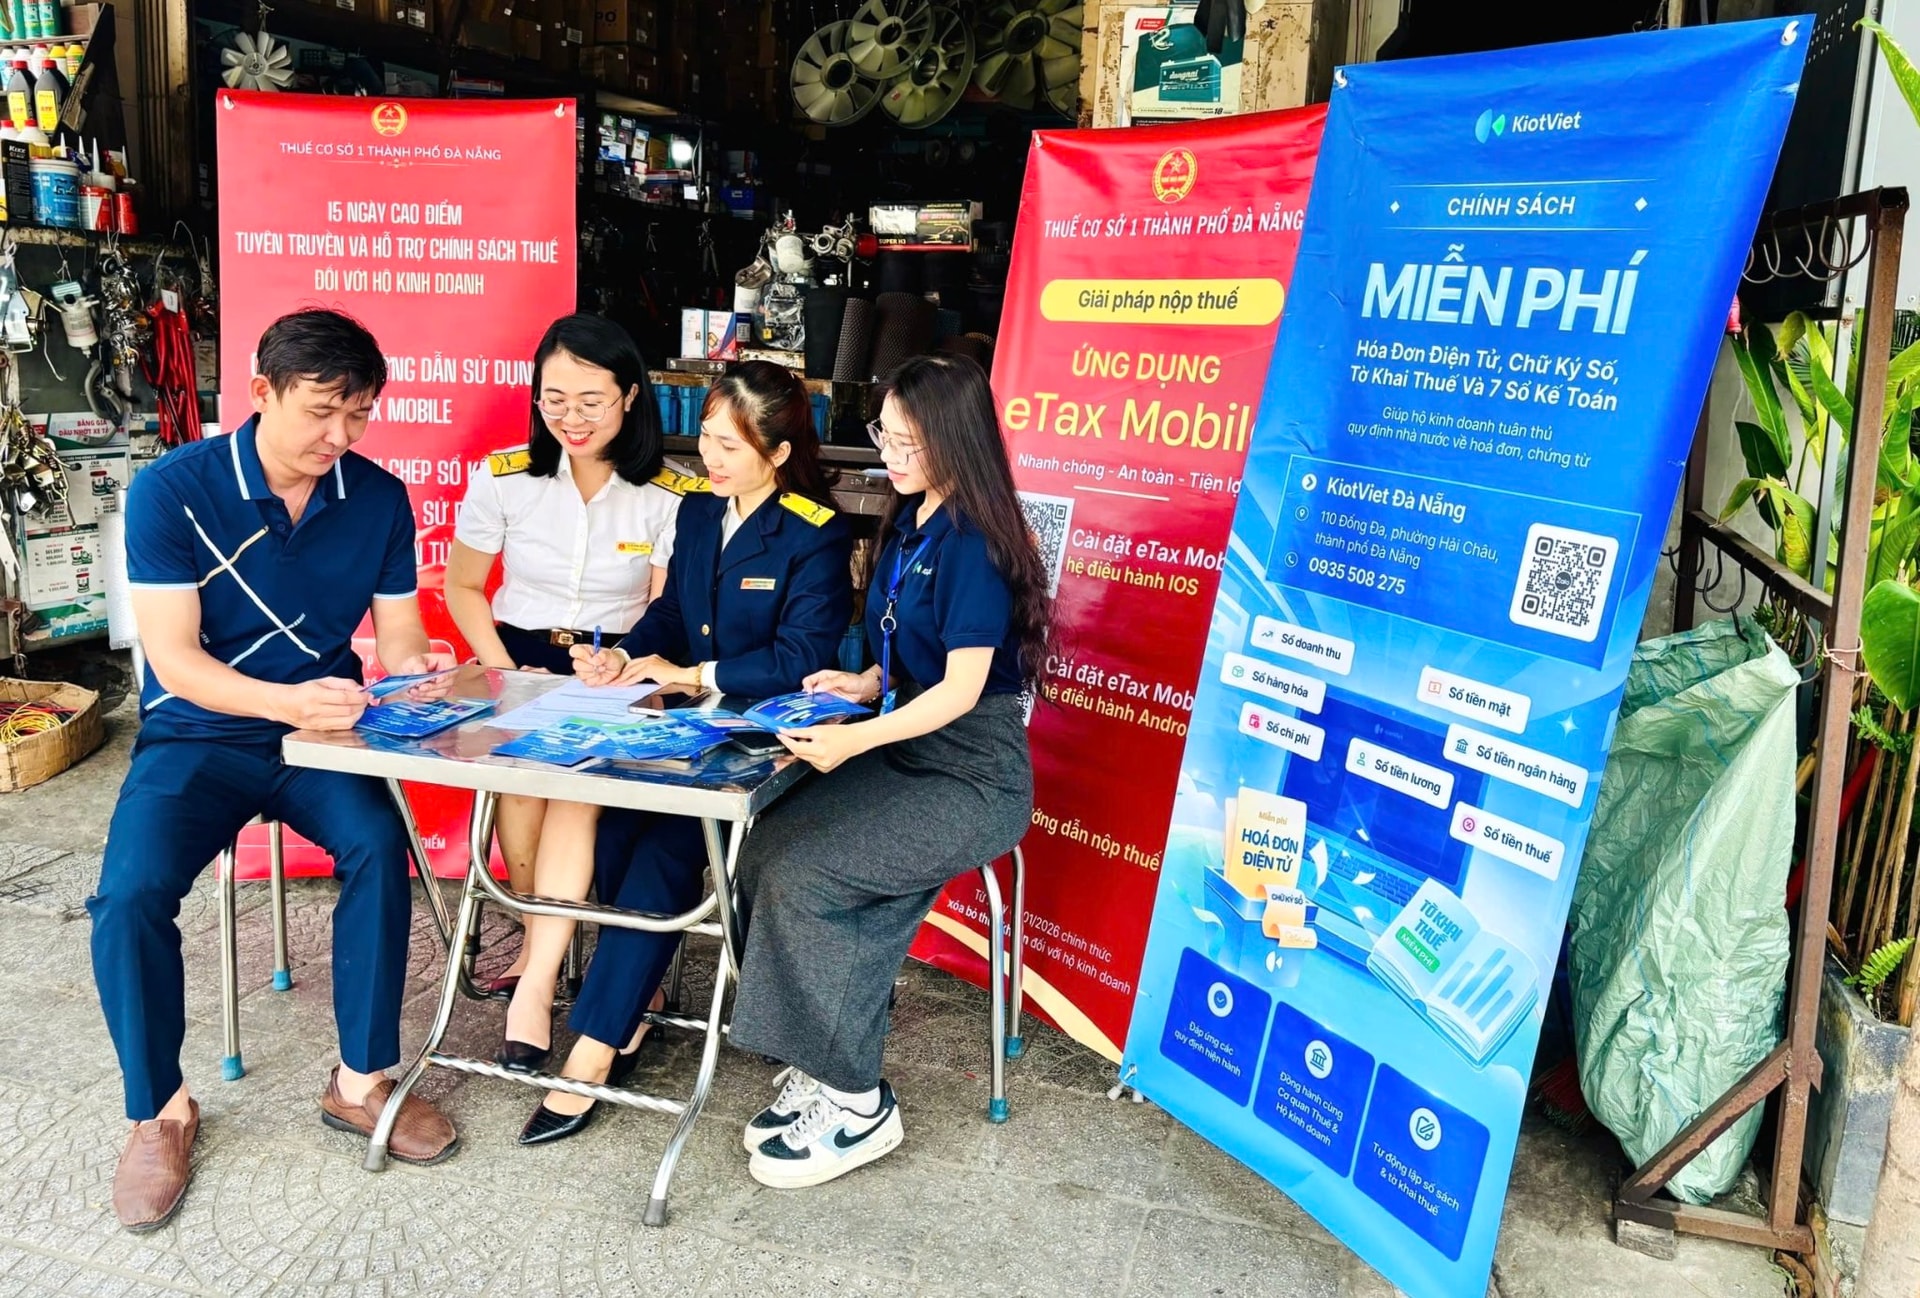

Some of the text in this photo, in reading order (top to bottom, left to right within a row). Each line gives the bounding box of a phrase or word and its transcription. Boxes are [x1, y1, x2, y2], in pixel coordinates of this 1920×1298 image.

[1512, 111, 1582, 133] KiotViet
[280, 140, 501, 161] THUẾ CƠ SỞ 1 THÀNH PHỐ ĐÀ NẴNG
[327, 199, 462, 225] 15 NGÀY CAO ĐIỂM
[1044, 202, 1304, 238] THUẾ CƠ SỞ 1 THÀNH PHỐ ĐÀ NẴNG
[1447, 191, 1576, 216] CHÍNH SÁCH
[235, 229, 558, 263] TUYÊN TRUYỀN VÀ HỖ TRỢ CHÍNH SÁCH THUẾ
[315, 265, 484, 295] ĐỐI VỚI HỘ KINH DOANH
[1361, 243, 1649, 335] MIỄN PHÍ
[1078, 287, 1240, 314] Giải pháp nộp thuế
[421, 351, 457, 383] DẪN
[463, 354, 489, 384] SỬ
[1072, 342, 1221, 389] ỨNG DỤNG
[1356, 339, 1620, 384] Hóa Đơn Điện Tử, Chữ Ký Số,
[1350, 365, 1369, 384] Tờ
[1371, 367, 1408, 389] Khai
[1413, 370, 1461, 393] Thuế
[1462, 375, 1485, 397] Và
[1488, 378, 1503, 398] 7
[1534, 382, 1564, 406] Kế
[1566, 386, 1618, 411] Toán
[387, 397, 452, 424] MOBILE
[1004, 391, 1252, 452] eTax Mobil
[1382, 406, 1409, 424] Giúp
[1411, 409, 1427, 427] hộ
[1429, 412, 1454, 428] kinh
[1456, 415, 1494, 434] doanh
[1498, 421, 1528, 437] tuân
[437, 454, 462, 485] SỔ
[1017, 453, 1223, 494] Nhanh chóng An toàn Tiện
[422, 496, 450, 526] SỬ
[1326, 476, 1467, 524] KiotViet Đà Nẵng
[1072, 528, 1180, 564] Cài đặt eTax
[1320, 510, 1337, 525] 110
[1369, 521, 1388, 540] Đa,
[1390, 525, 1437, 551] phường
[1438, 535, 1460, 552] Hải
[1462, 541, 1500, 564] Châu,
[1066, 556, 1199, 596] hệ điều hành IOS
[1308, 557, 1406, 595] 0935 508 275
[1295, 638, 1342, 661] doanh thu
[1266, 675, 1309, 698] hàng hóa
[1465, 691, 1512, 718] tiền mặt
[1280, 727, 1311, 746] chi phí
[1390, 763, 1442, 796] tiền lương
[1493, 750, 1577, 794] tiền ngân hàng
[1060, 818, 1162, 871] dẫn nộp thuế
[1241, 828, 1299, 854] HOÁ ĐƠN
[1500, 831, 1554, 863] tiền thuế
[1243, 850, 1293, 873] ĐIỆN TỬ
[1415, 919, 1449, 951] THUẾ
[1432, 911, 1463, 942] KHAI
[1029, 936, 1132, 995] đối với hộ kinh doanh
[1189, 1021, 1234, 1056] Đáp ứng các
[1277, 1087, 1332, 1129] Cơ quan Thuế
[1280, 1071, 1344, 1122] Đồng hành cùng
[1276, 1102, 1331, 1146] Hộ kinh doanh
[1388, 1172, 1440, 1216] tờ khai thuế
